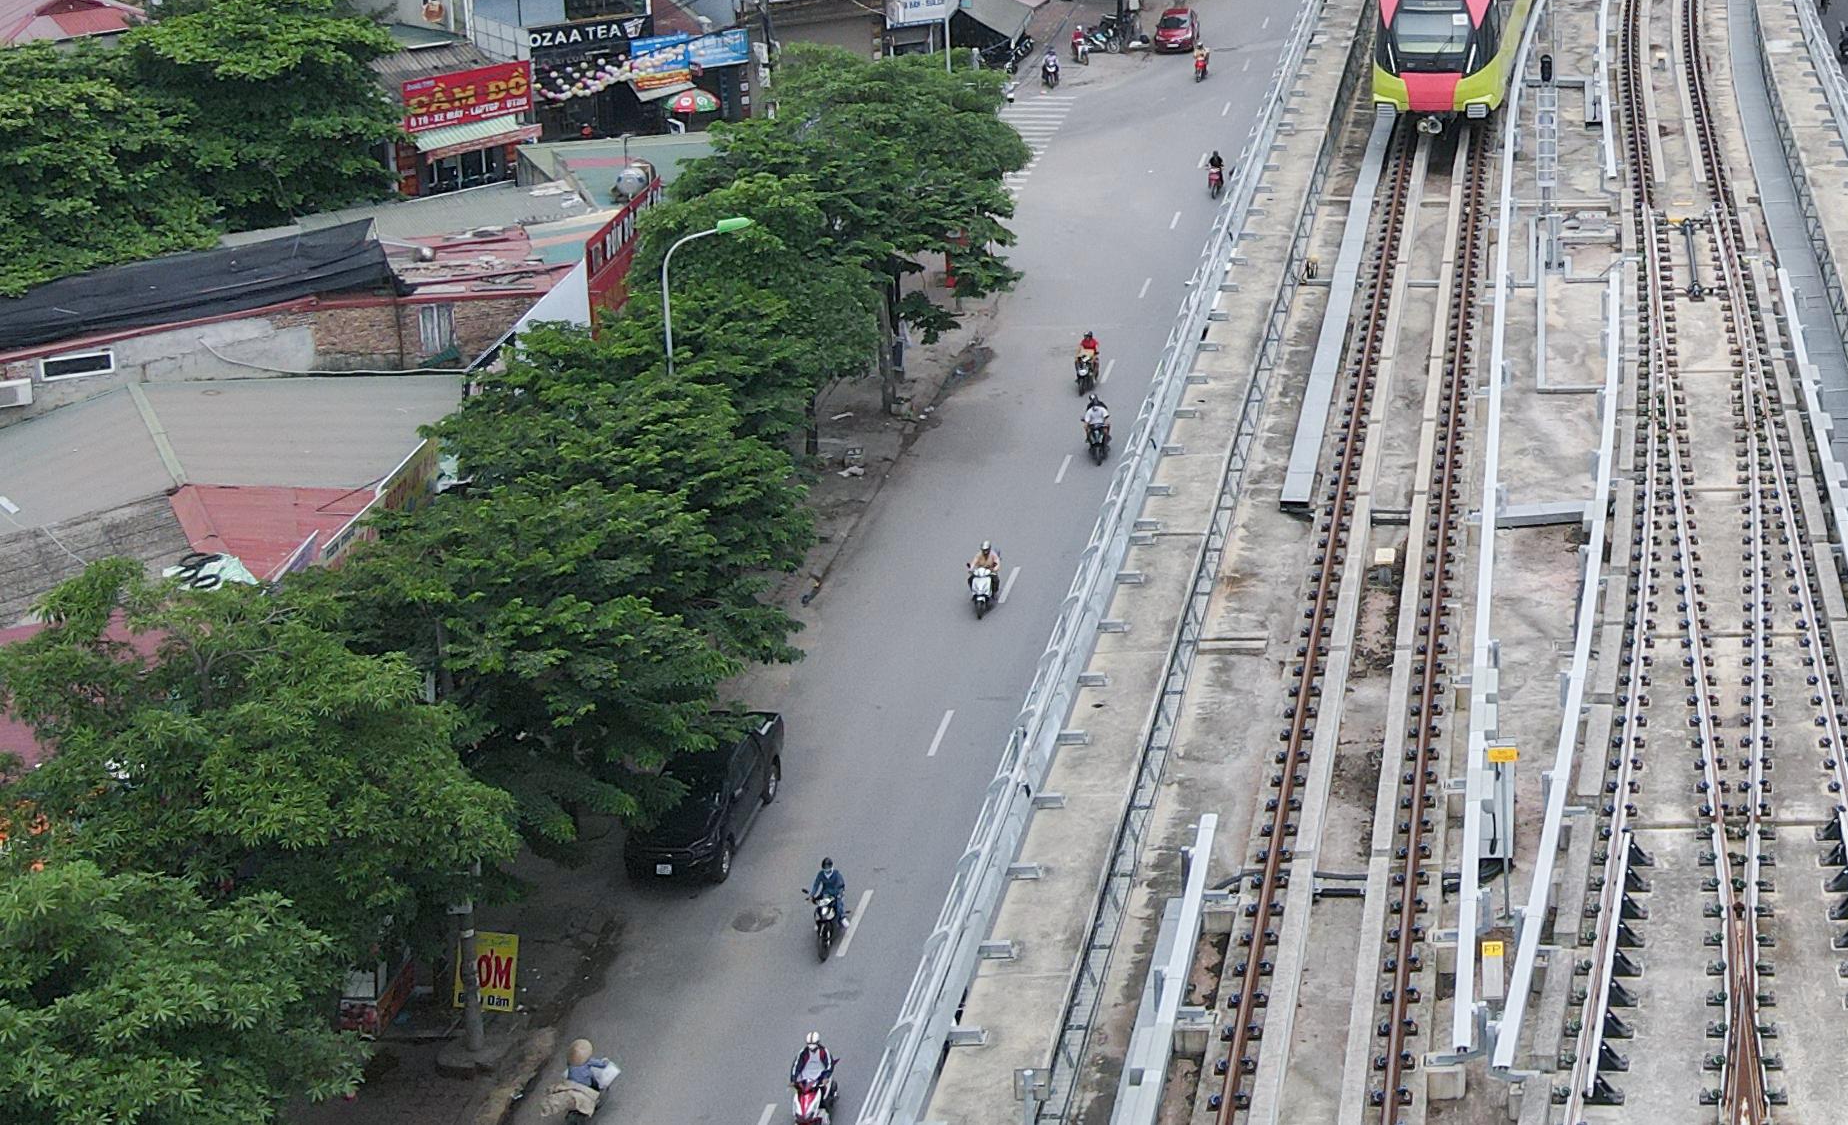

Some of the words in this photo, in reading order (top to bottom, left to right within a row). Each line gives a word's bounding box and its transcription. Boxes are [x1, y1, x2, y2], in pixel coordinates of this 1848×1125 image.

[585, 24, 622, 41] TEA
[408, 82, 477, 115] CẦM
[487, 66, 528, 101] ĐỒ
[434, 111, 445, 122] XE
[470, 102, 500, 115] LAPTOP
